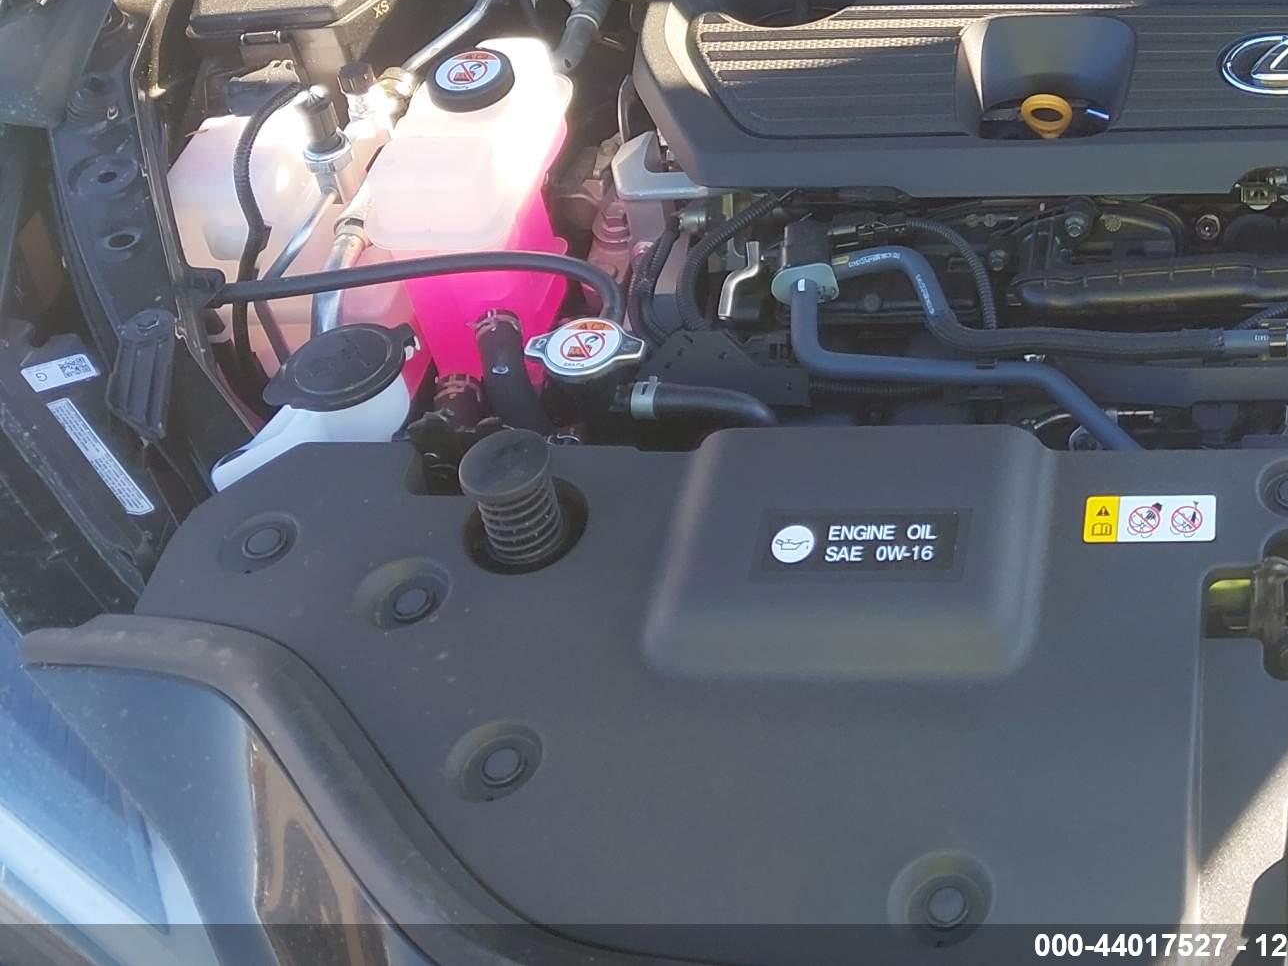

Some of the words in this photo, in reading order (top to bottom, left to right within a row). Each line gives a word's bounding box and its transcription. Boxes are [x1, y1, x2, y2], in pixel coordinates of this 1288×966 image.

[372, 0, 390, 19] XS
[828, 524, 895, 541] ENGINE
[906, 524, 937, 540] OIL
[824, 545, 863, 562] SAE
[875, 545, 934, 561] 0W-16
